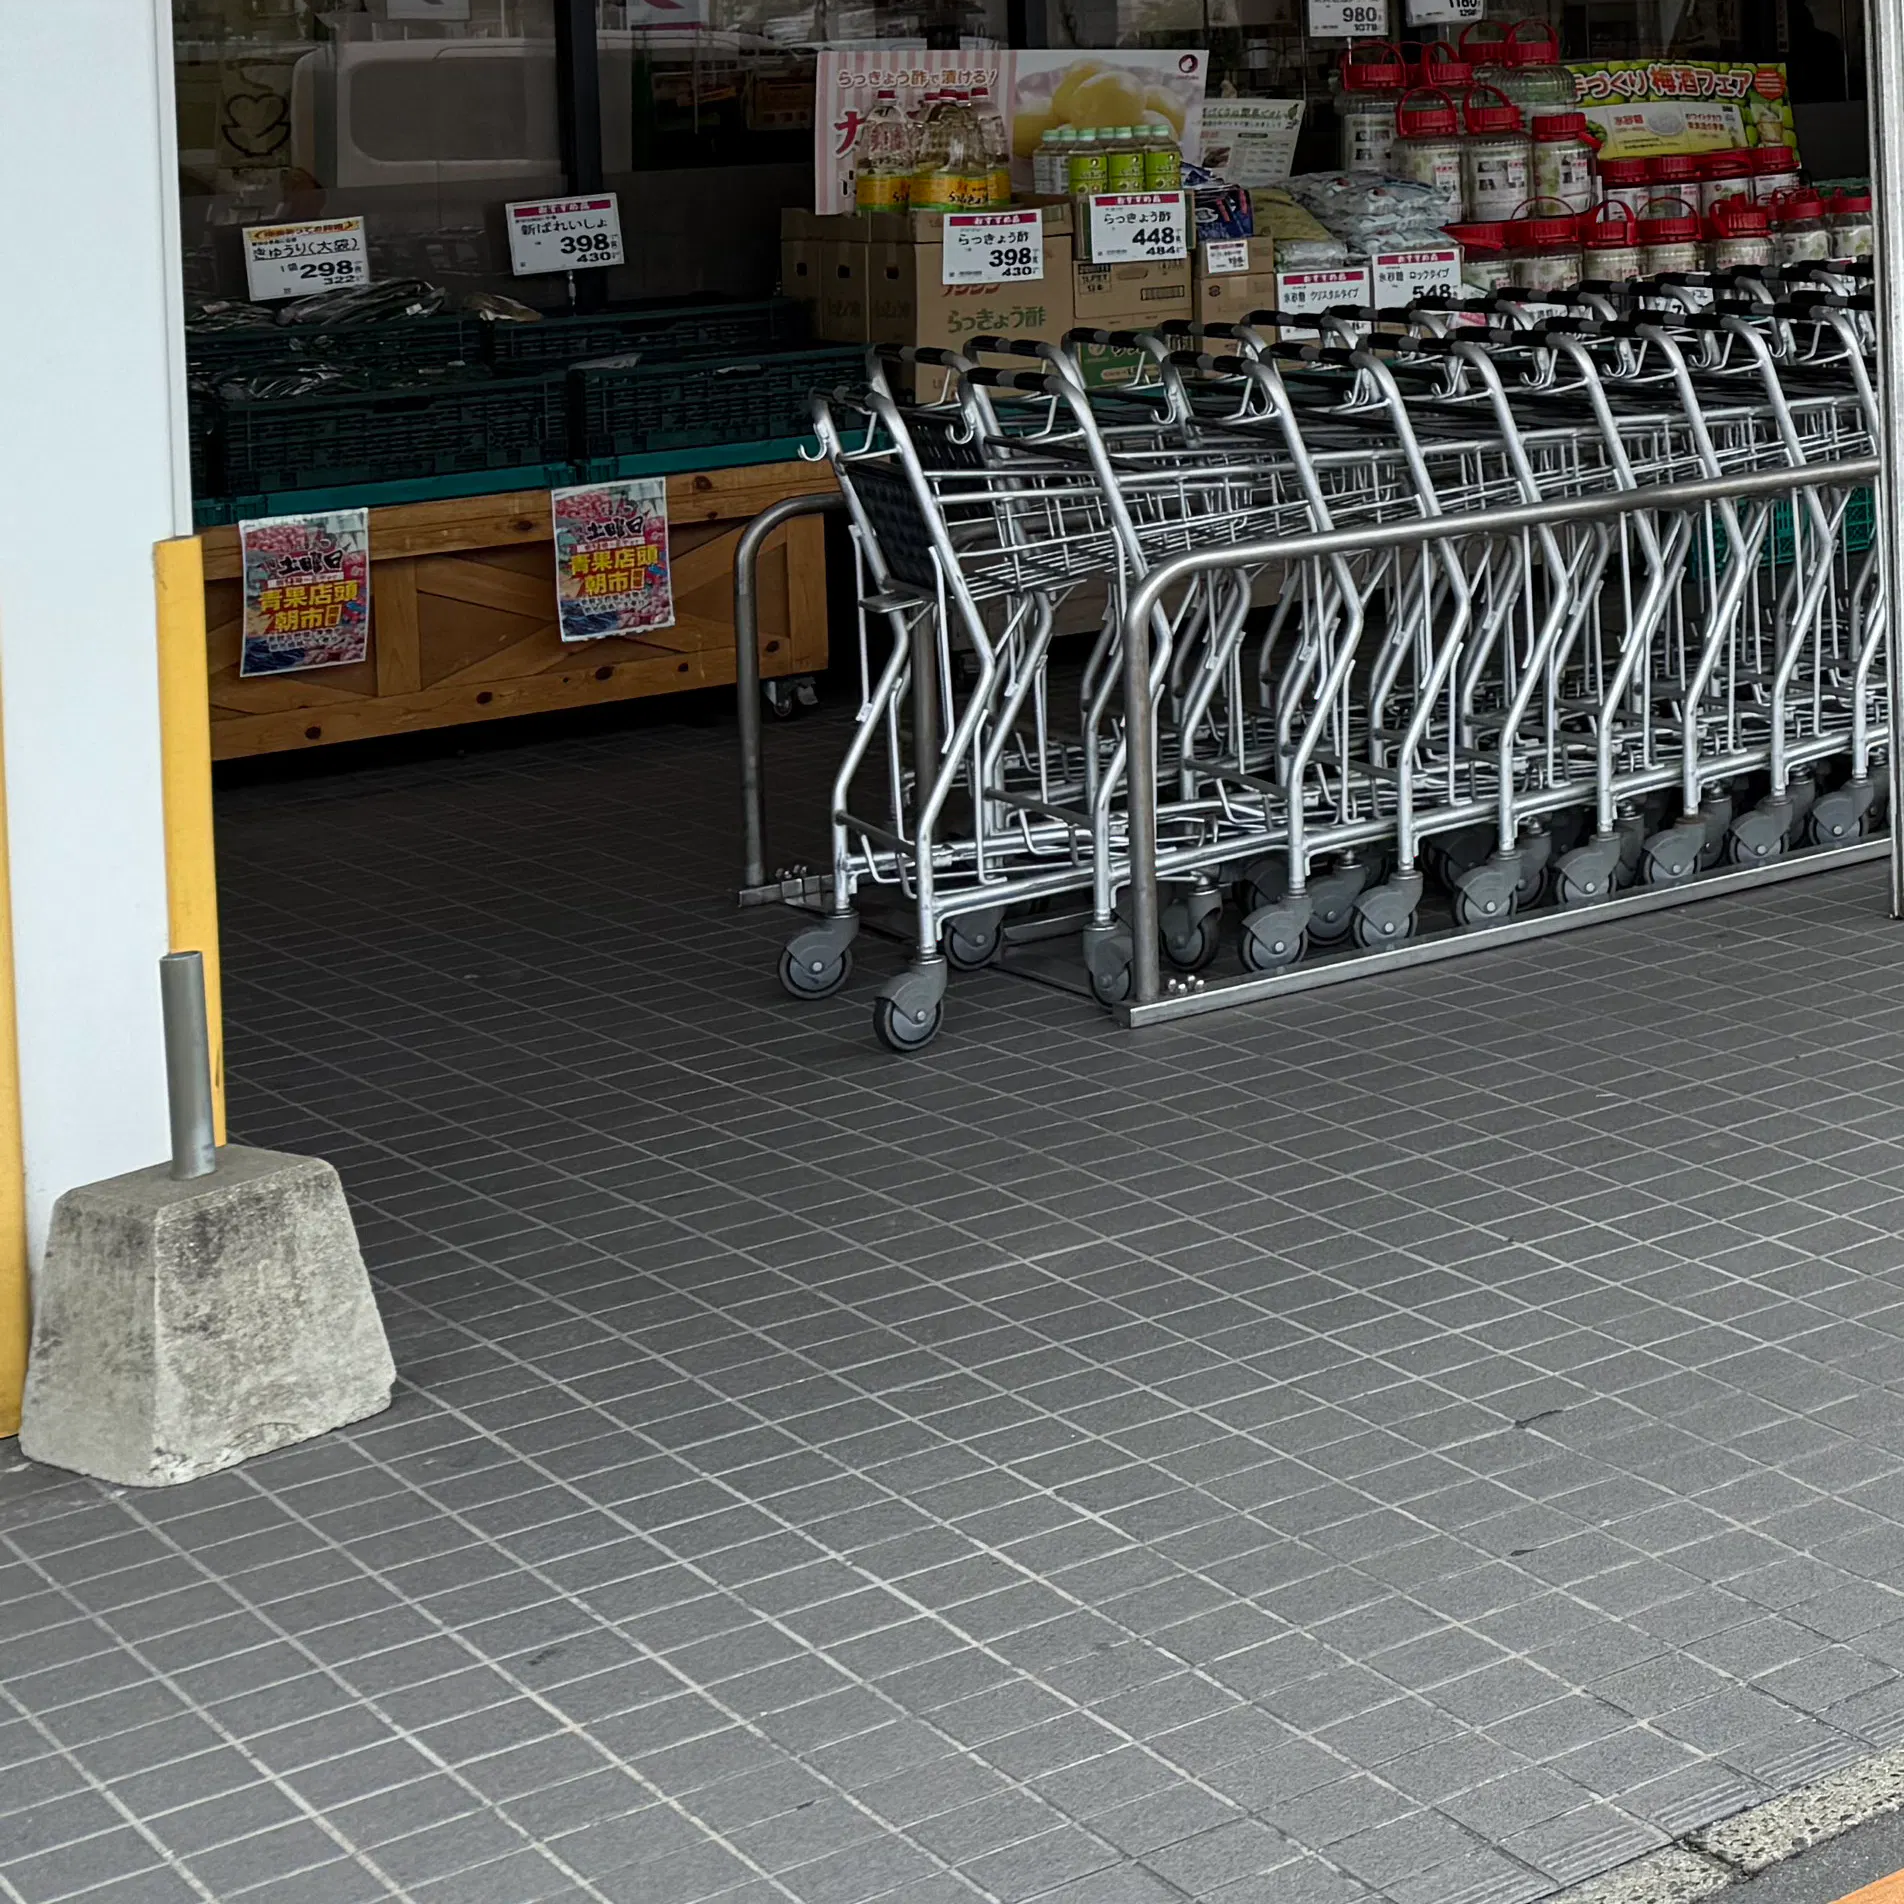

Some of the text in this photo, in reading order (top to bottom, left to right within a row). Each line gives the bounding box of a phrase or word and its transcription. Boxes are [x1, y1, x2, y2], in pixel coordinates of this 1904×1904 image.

[1343, 7, 1377, 22] 980
[1116, 195, 1161, 205] おすすめ品
[973, 213, 1021, 225] おすすめ品
[1104, 211, 1171, 225] らっきょう酢
[521, 218, 608, 237] 新ばれいしょ
[1132, 227, 1175, 245] 448
[560, 233, 609, 254] 398
[958, 231, 1029, 246] らっきょう酢
[253, 237, 360, 262] きゅうり(大袋)
[577, 251, 611, 263] 430
[989, 248, 1032, 267] 398
[1146, 245, 1175, 255] 484
[300, 259, 354, 279] 298
[1001, 266, 1033, 276] 430
[1413, 285, 1452, 298] 548
[947, 306, 1046, 333] らっきょう酢
[587, 516, 644, 541] 土曜日
[278, 549, 343, 576] 土曜日
[570, 545, 659, 575] 青果店頭
[259, 580, 360, 612] 青果店頭
